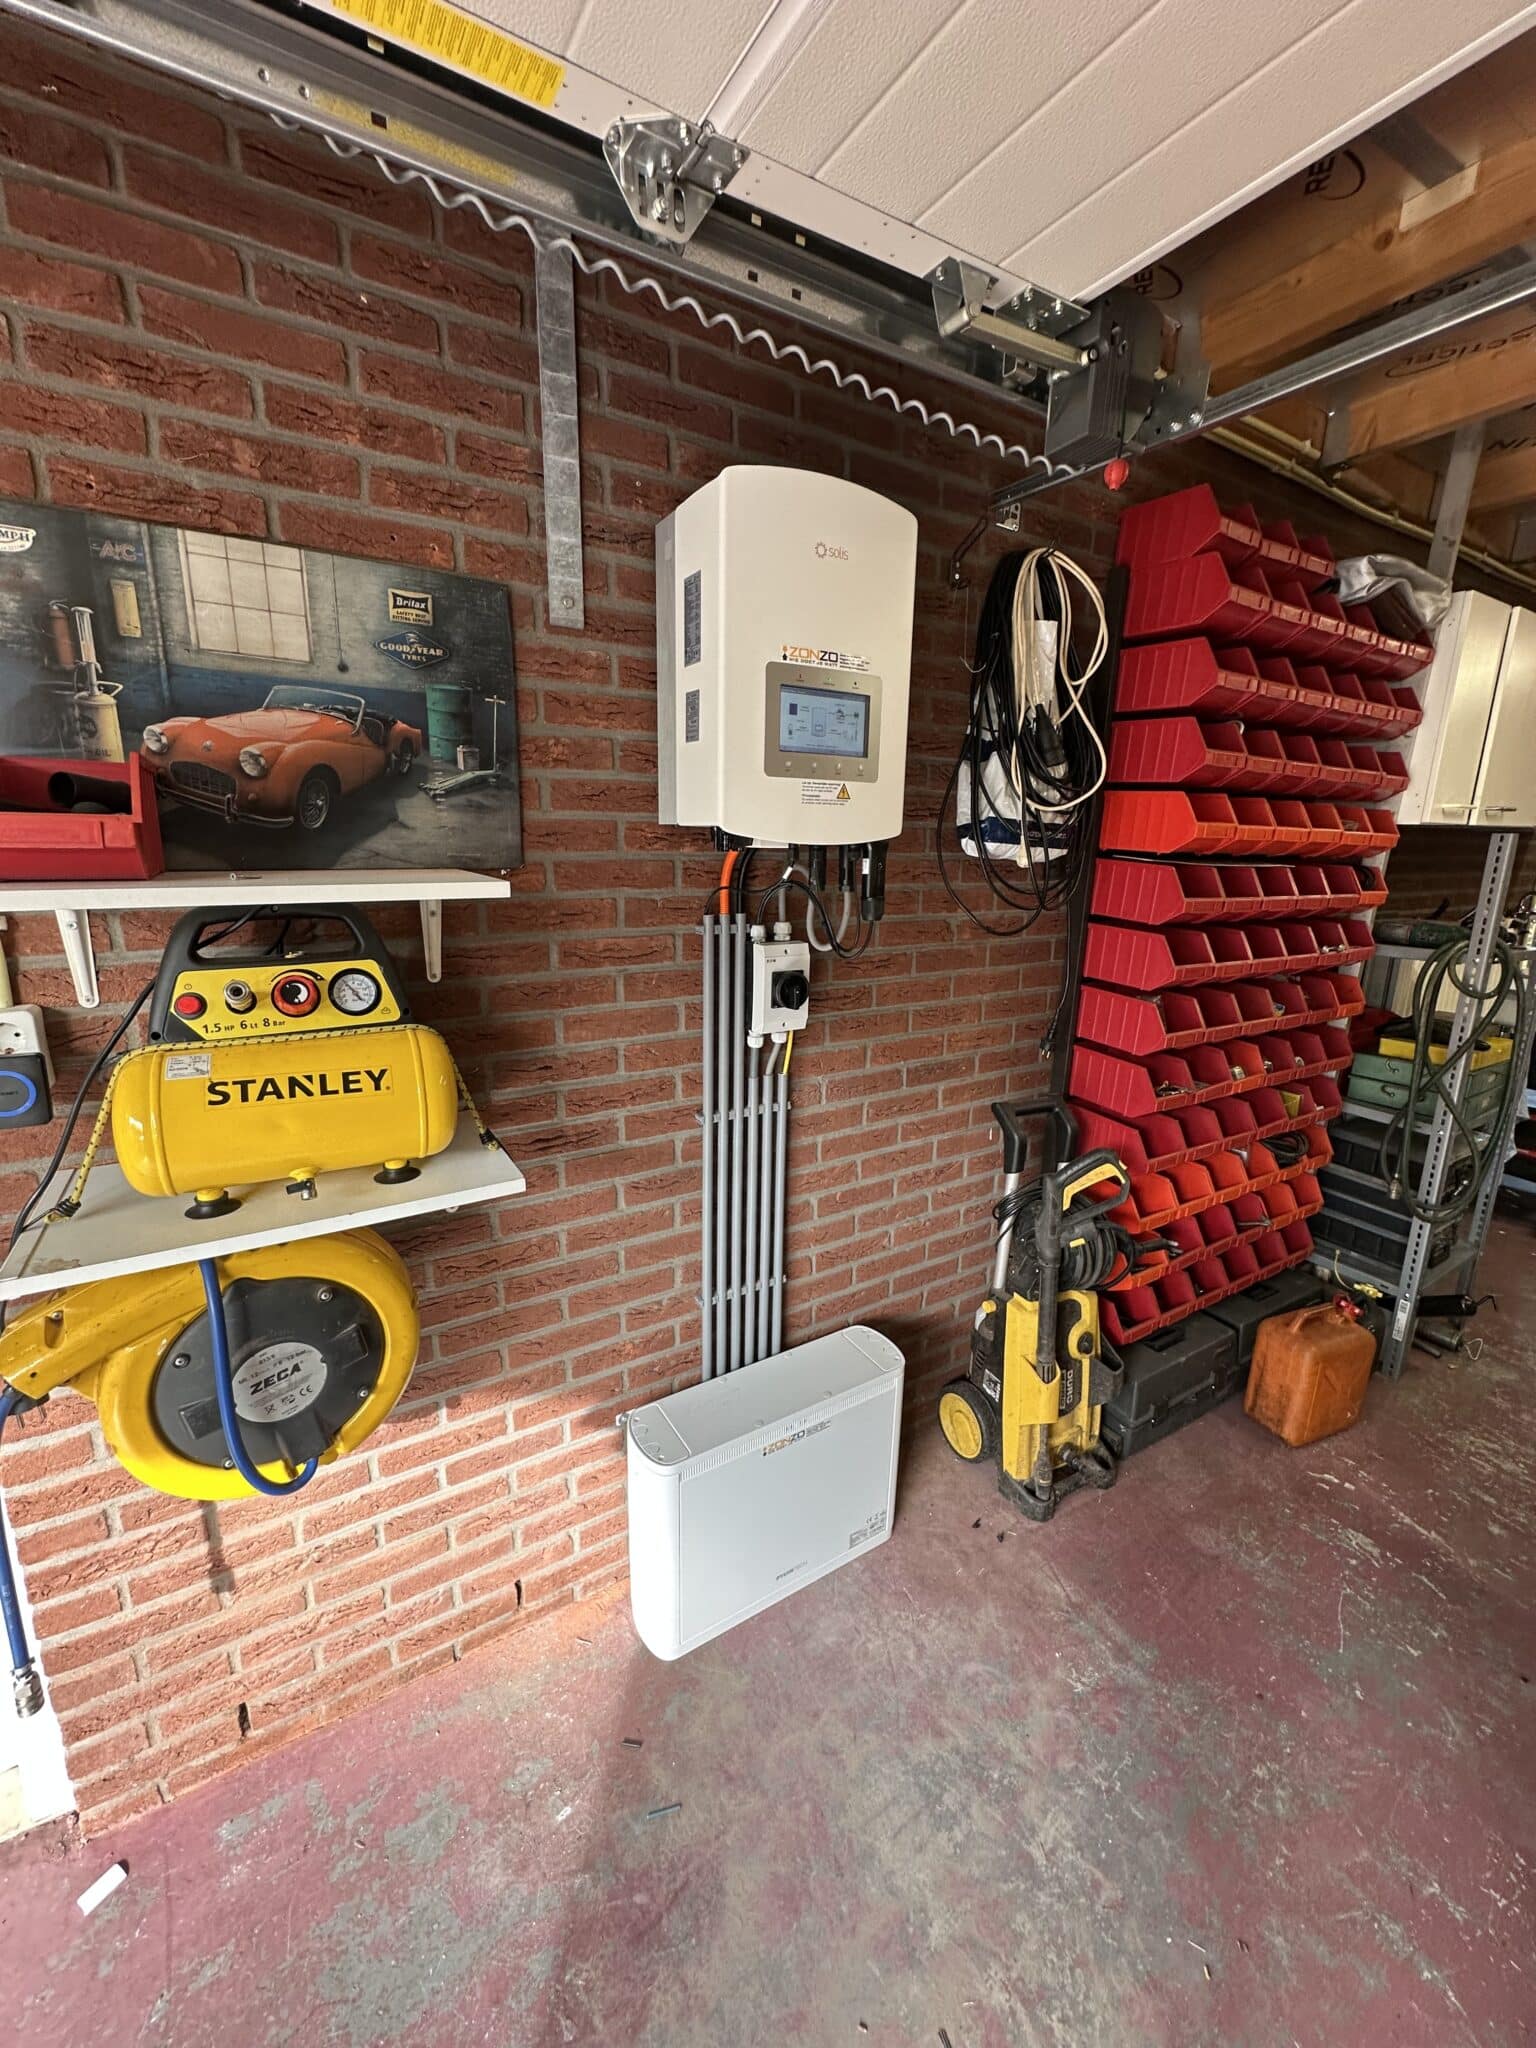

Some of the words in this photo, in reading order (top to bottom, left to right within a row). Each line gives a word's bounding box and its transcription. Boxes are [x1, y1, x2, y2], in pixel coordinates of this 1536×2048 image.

[829, 546, 849, 561] solis
[789, 646, 839, 663] ZONZO
[202, 1022, 222, 1034] 1.5
[240, 1019, 248, 1030] 6
[262, 1017, 271, 1028] 8
[207, 1068, 389, 1106] STANLEY
[250, 1362, 302, 1396] ZECA
